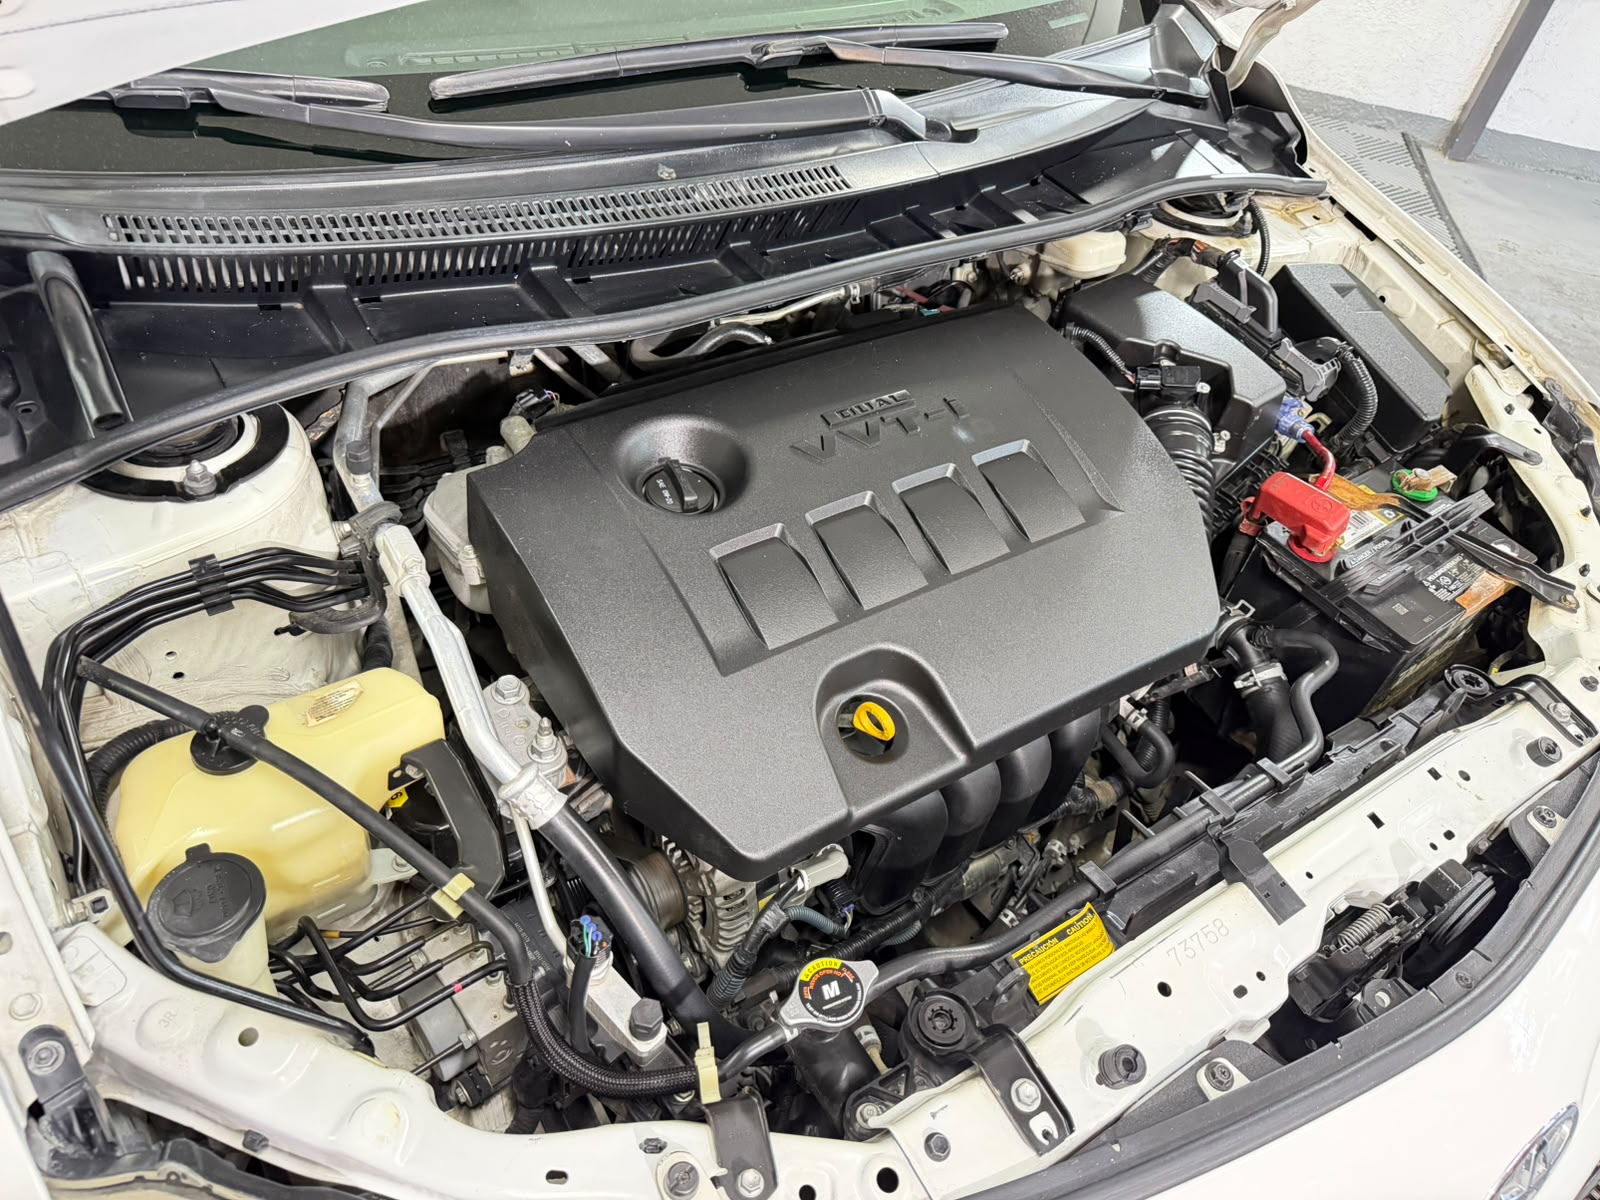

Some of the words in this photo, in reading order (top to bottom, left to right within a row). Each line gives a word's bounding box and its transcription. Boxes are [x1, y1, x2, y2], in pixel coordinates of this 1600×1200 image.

[1018, 936, 1059, 965] PRECAUCIÓN
[1066, 912, 1094, 936] CAUTION
[1165, 917, 1230, 967] 73758
[807, 960, 838, 974] CAUTION
[821, 980, 841, 1000] M
